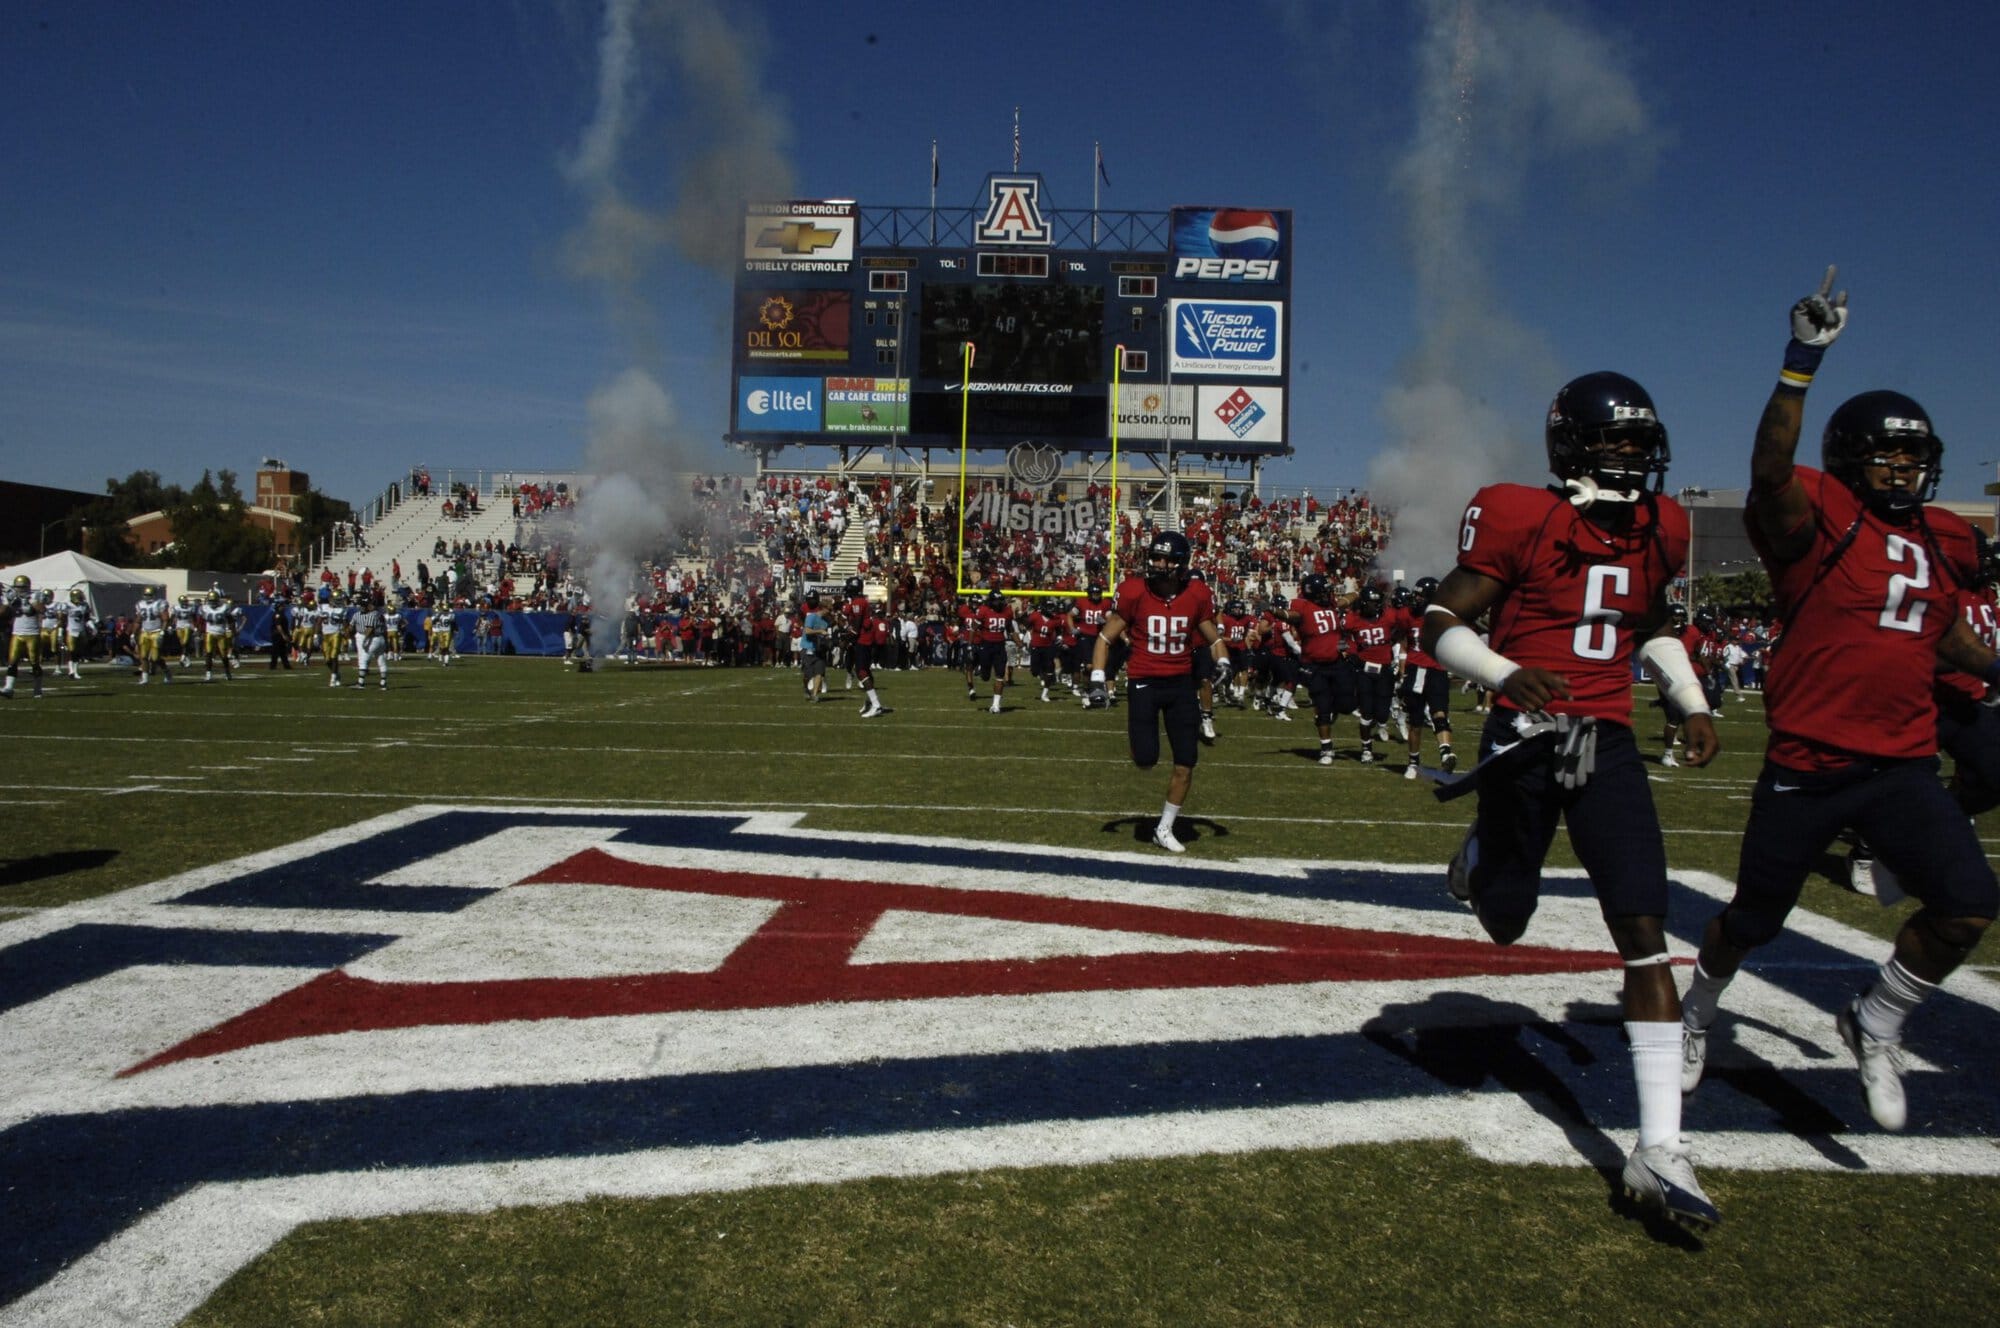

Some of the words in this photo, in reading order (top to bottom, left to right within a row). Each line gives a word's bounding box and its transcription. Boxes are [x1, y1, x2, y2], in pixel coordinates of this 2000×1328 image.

[791, 205, 851, 215] CHEVROLET
[976, 178, 1051, 245] A
[790, 262, 850, 272] CHEVROLET
[939, 260, 956, 269] TOL
[1069, 262, 1087, 271] TOL
[1174, 257, 1279, 281] PEPSI
[1201, 310, 1253, 326] Tucson
[748, 331, 772, 348] DEL
[778, 331, 803, 348] SOL
[1206, 324, 1267, 340] Electric
[1212, 337, 1265, 353] Power
[1218, 363, 1242, 371] Energy
[1243, 363, 1275, 371] Company
[829, 392, 845, 401] CAR
[848, 392, 869, 402] CARE
[965, 490, 1096, 534] Allstate
[1461, 506, 1482, 551] 6
[1878, 534, 1931, 634] 2
[1572, 563, 1631, 661] 6
[989, 617, 1007, 633] 28
[1313, 610, 1337, 634] 57
[1147, 615, 1189, 655] 85
[1359, 627, 1386, 645] 32
